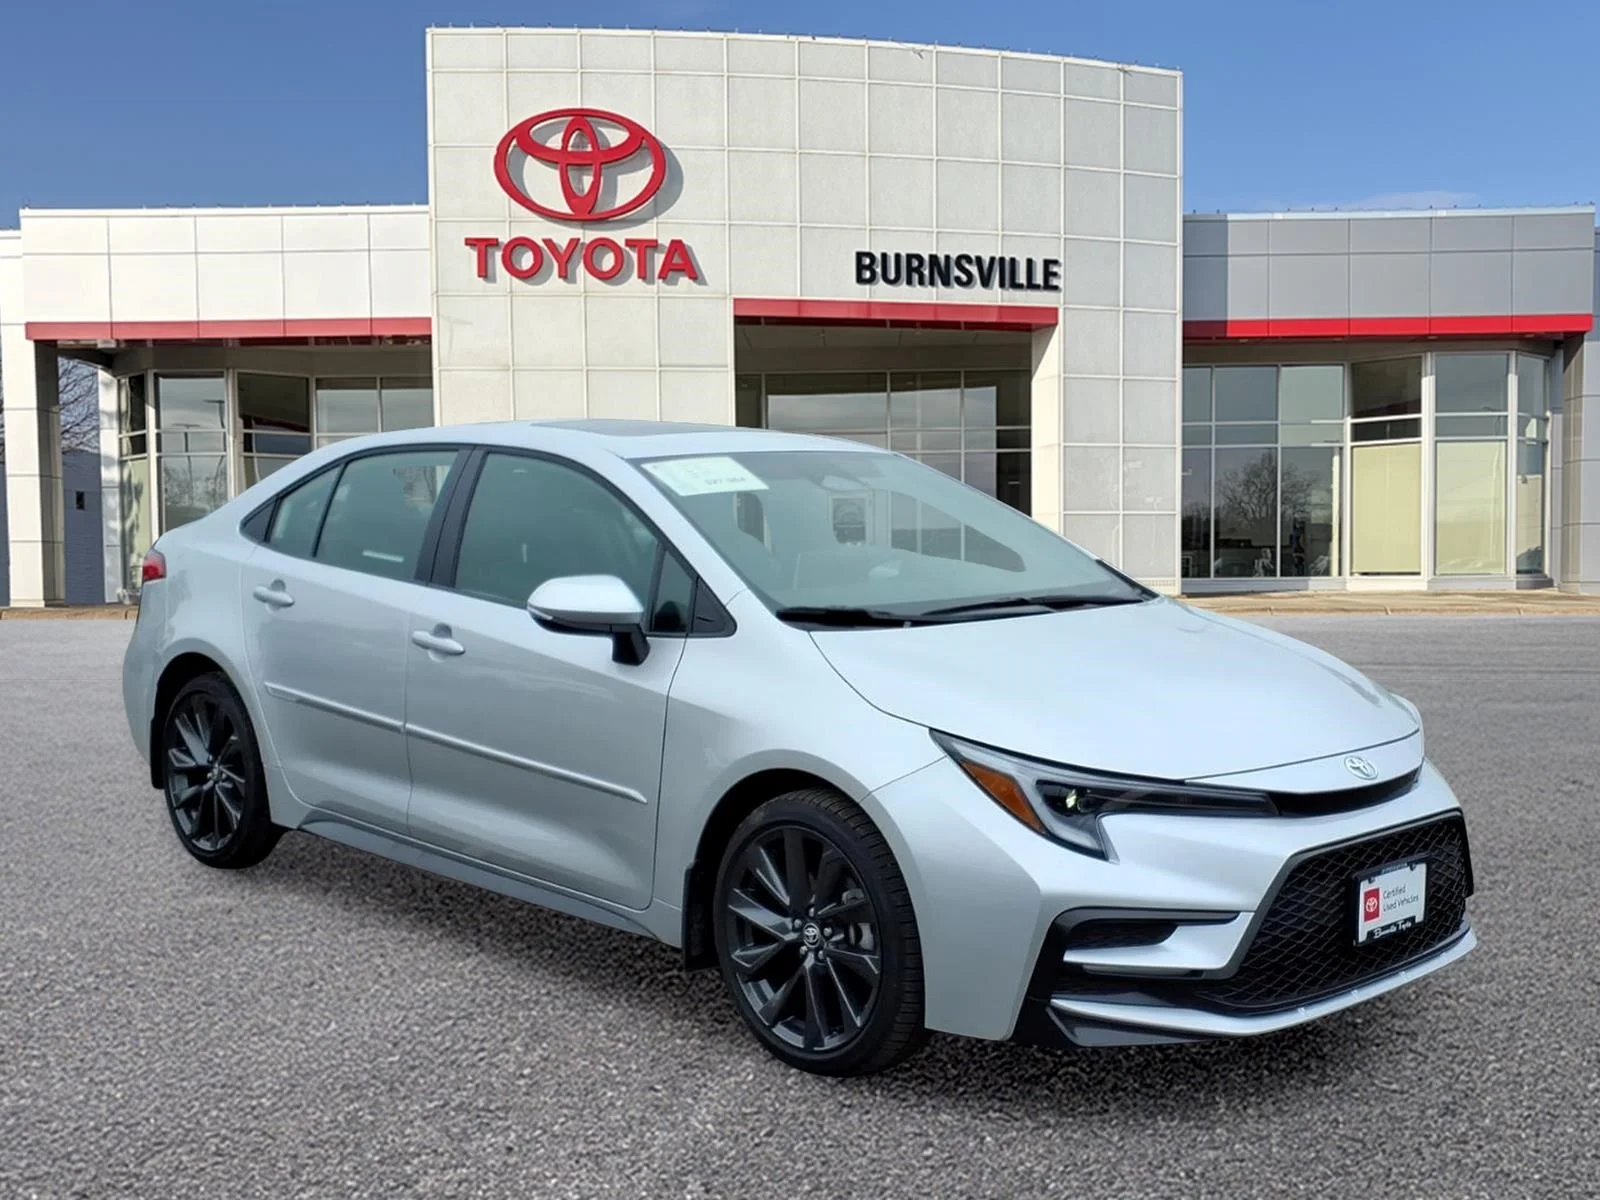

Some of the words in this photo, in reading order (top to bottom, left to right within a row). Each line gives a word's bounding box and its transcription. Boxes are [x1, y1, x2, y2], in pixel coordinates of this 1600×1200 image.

[464, 236, 699, 281] TOYOTA
[855, 250, 1061, 291] BURNSVILLE
[1383, 885, 1406, 899] Certified
[1397, 895, 1419, 907] Vehicles
